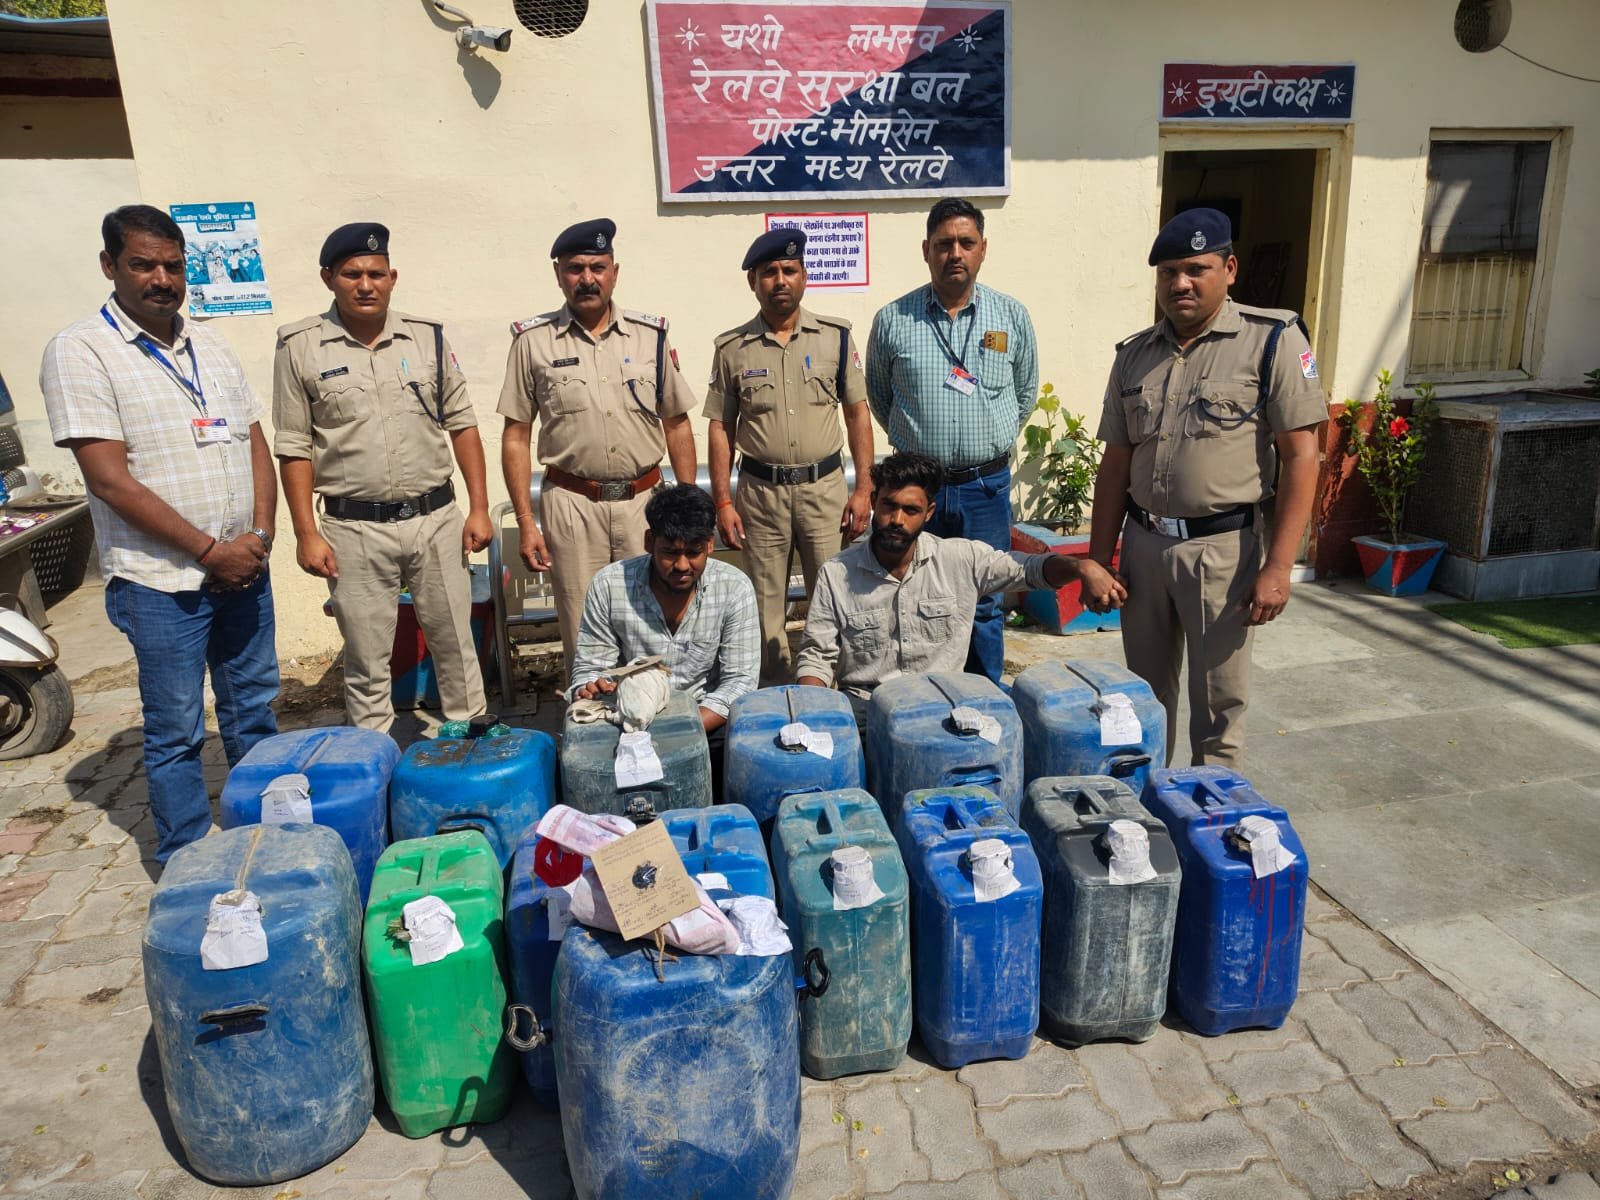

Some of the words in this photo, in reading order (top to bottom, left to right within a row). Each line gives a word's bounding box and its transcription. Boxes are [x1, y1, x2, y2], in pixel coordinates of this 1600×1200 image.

[720, 14, 784, 55] यशो
[847, 24, 945, 56] लभस्व
[690, 58, 792, 104] रेलवे
[797, 69, 905, 117] सुरक्षा
[909, 72, 971, 105] बल
[1195, 70, 1273, 117] ड्यूटी
[1272, 76, 1326, 114] कक्ष
[693, 155, 786, 186] उत्तर
[805, 155, 872, 182] मध्य
[878, 146, 954, 185] रेलवे
